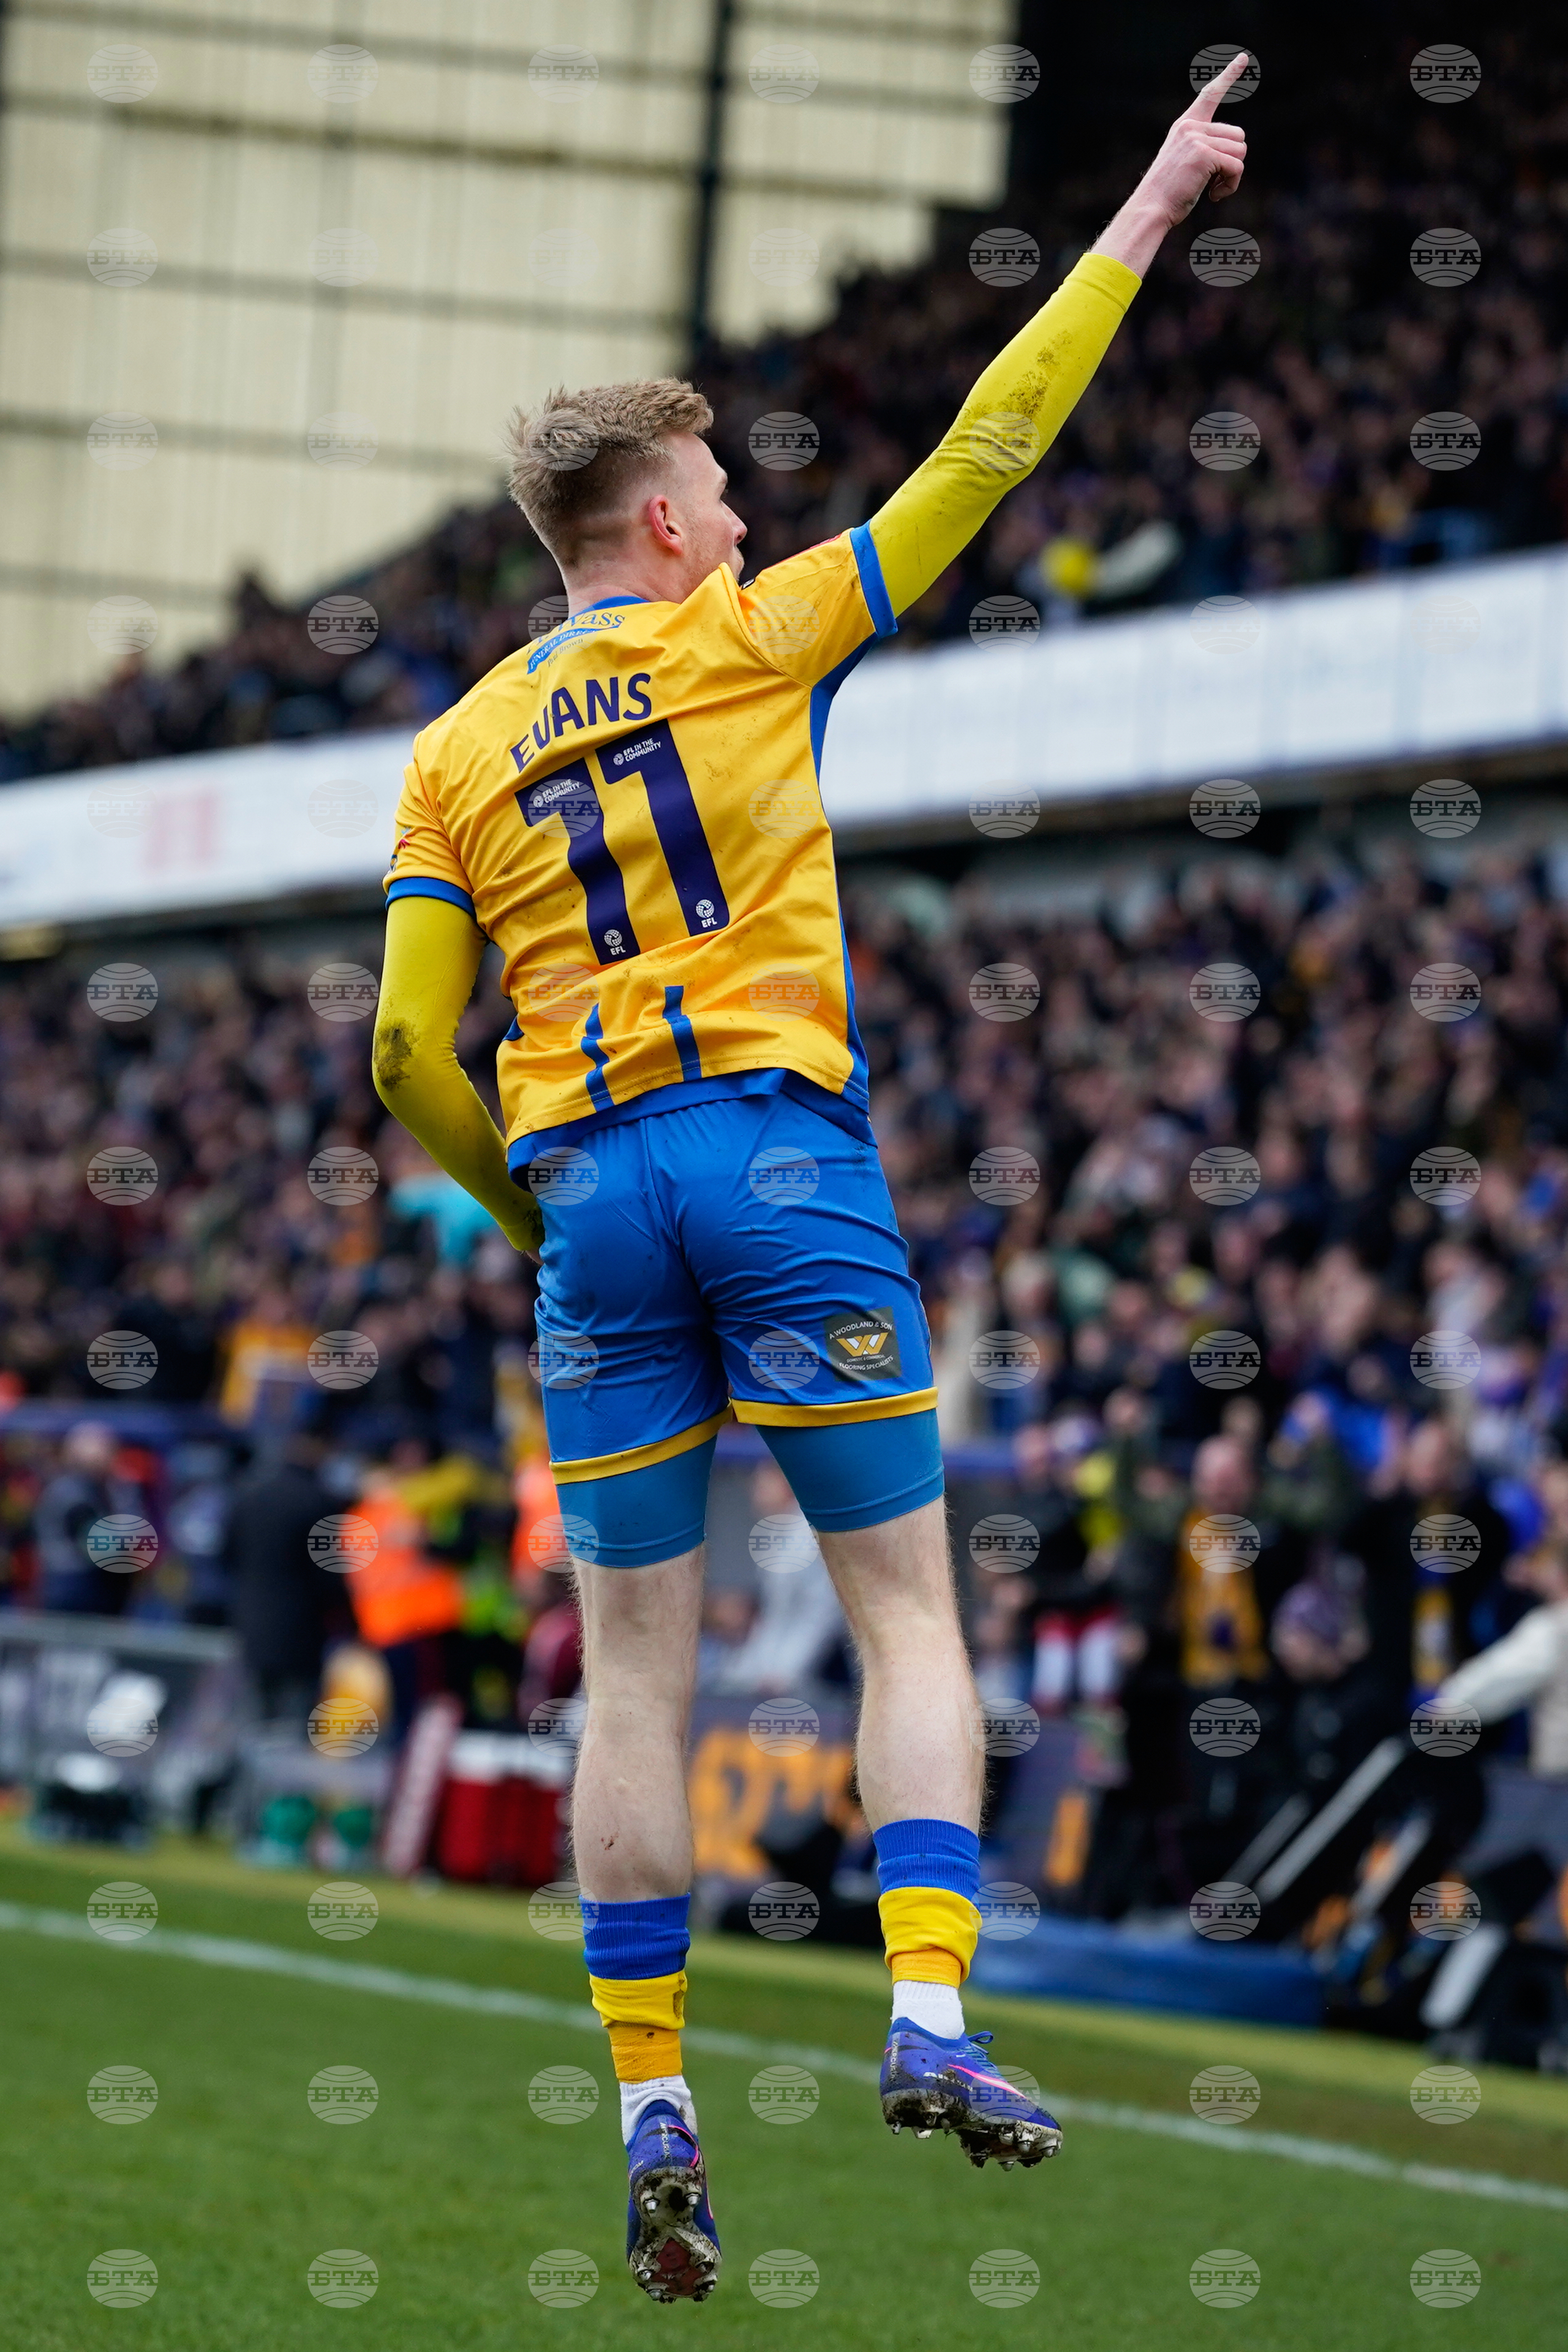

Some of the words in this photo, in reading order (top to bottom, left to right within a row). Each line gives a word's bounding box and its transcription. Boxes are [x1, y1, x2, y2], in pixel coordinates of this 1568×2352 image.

[510, 673, 652, 774] EVANS
[623, 747, 635, 756] EFL
[641, 737, 654, 747] THE
[625, 741, 661, 762] COMMUNITY
[542, 788, 553, 797] EFL
[552, 784, 560, 793] IN
[560, 778, 572, 788] THE
[544, 782, 580, 804] COMMUNITY
[514, 718, 729, 966] 11
[701, 917, 717, 928] EFL
[609, 945, 626, 956] EFL
[834, 1321, 873, 1336] WOODLAND
